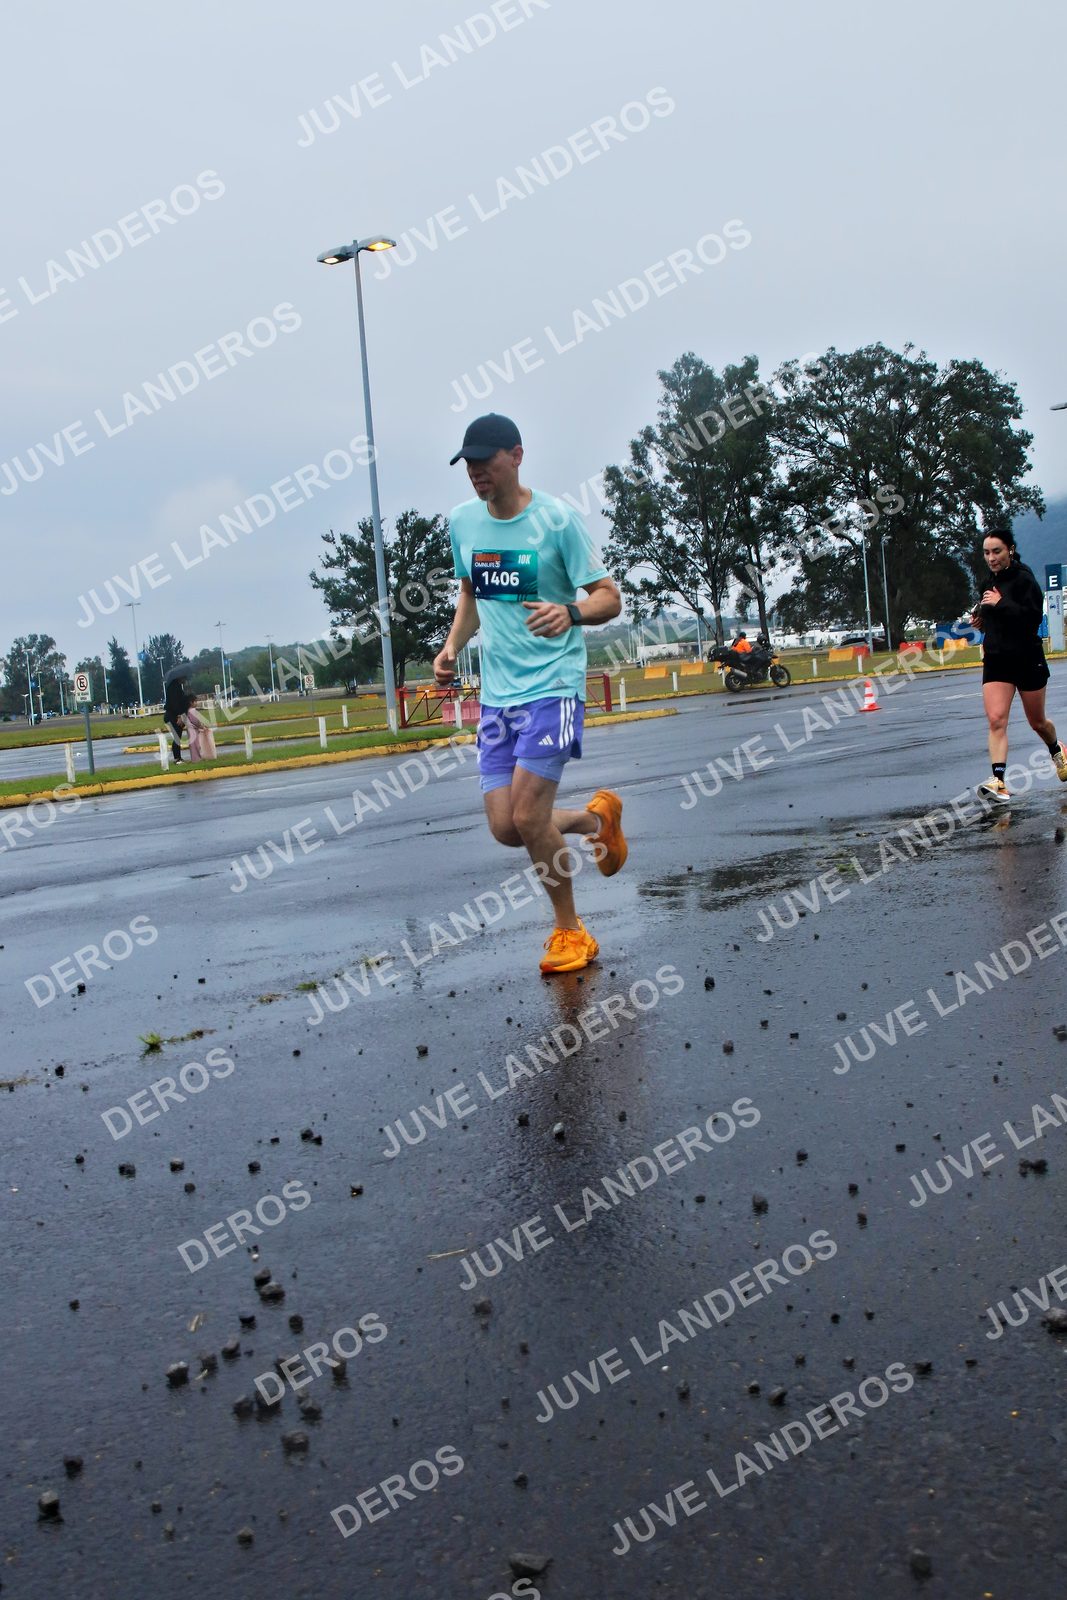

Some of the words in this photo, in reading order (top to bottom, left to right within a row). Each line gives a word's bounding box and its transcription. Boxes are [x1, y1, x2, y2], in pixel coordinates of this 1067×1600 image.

[518, 554, 531, 565] 10K
[482, 571, 519, 586] 1406
[1049, 575, 1058, 587] E
